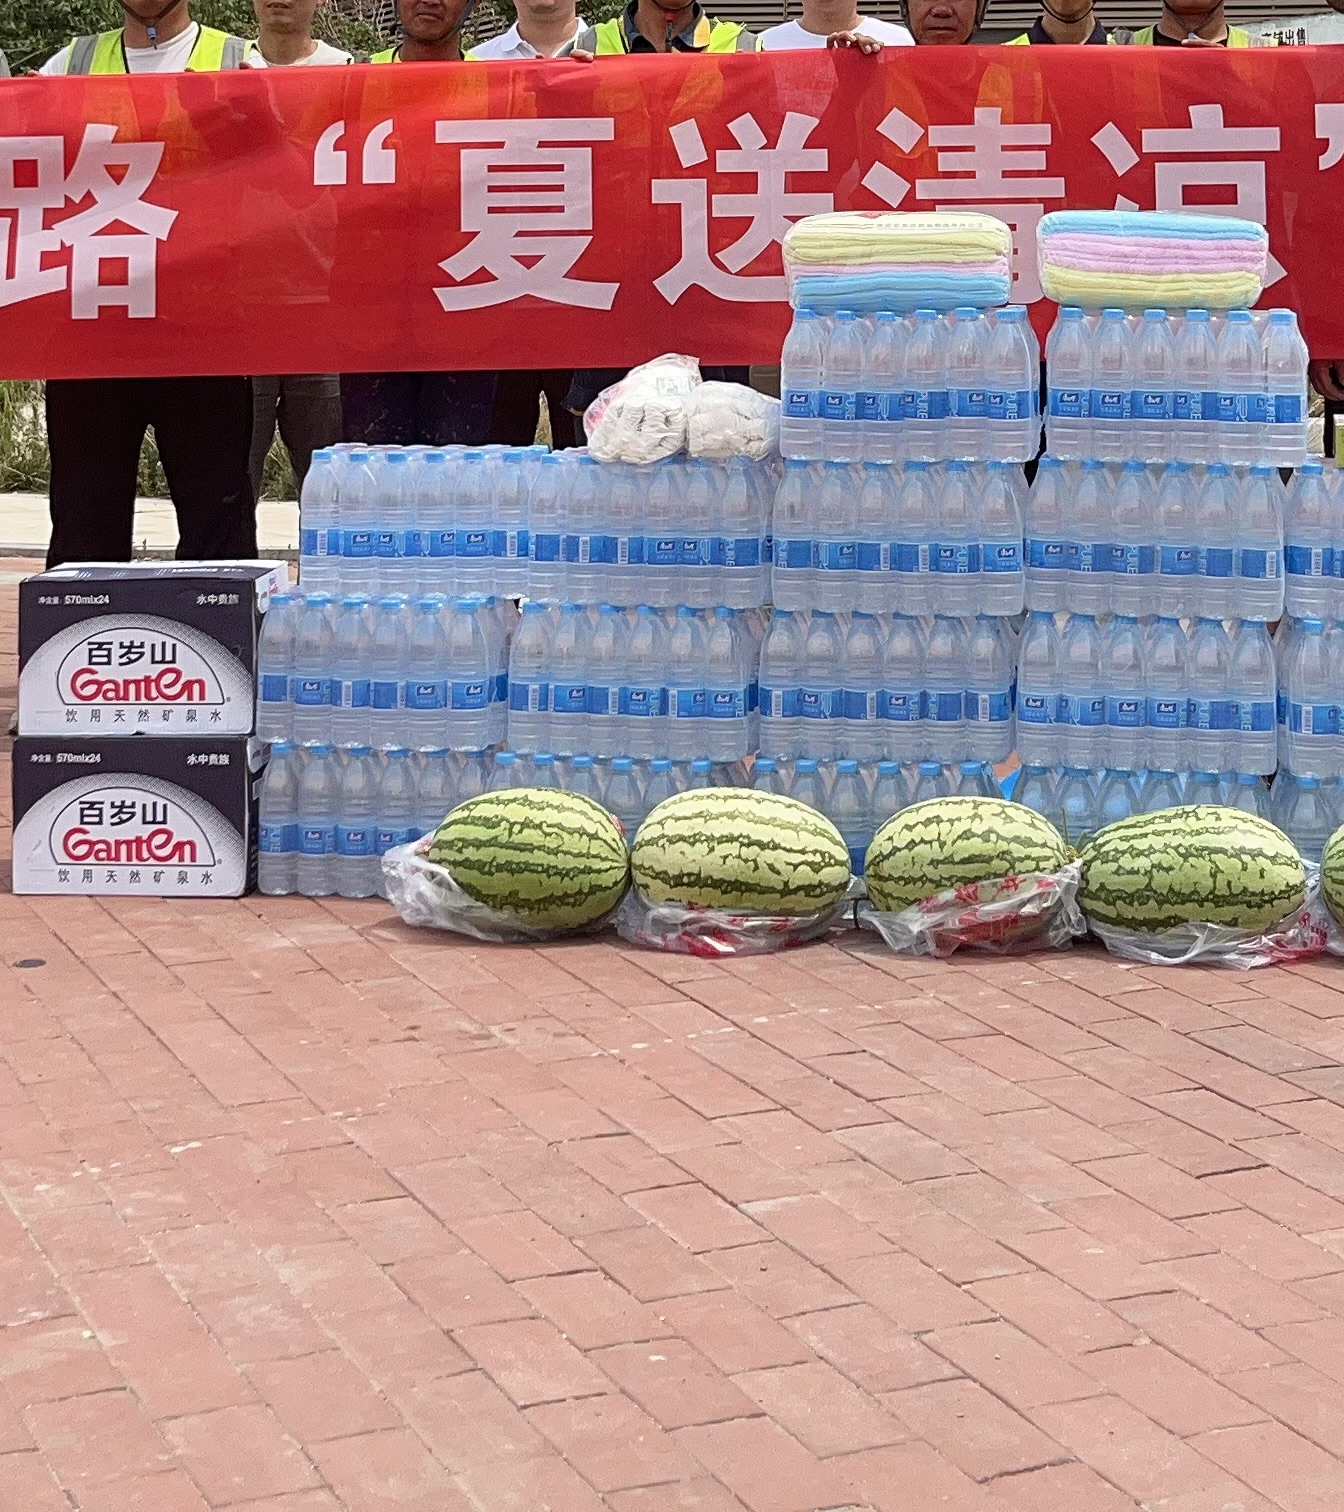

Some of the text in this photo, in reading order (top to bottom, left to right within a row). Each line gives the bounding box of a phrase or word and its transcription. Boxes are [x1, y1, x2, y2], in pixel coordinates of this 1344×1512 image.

[87, 639, 178, 667] 百岁山
[65, 708, 222, 723] 饮用天然矿泉水
[79, 799, 168, 827] 百岁山
[57, 868, 213, 886] 饮用天然矿泉水
